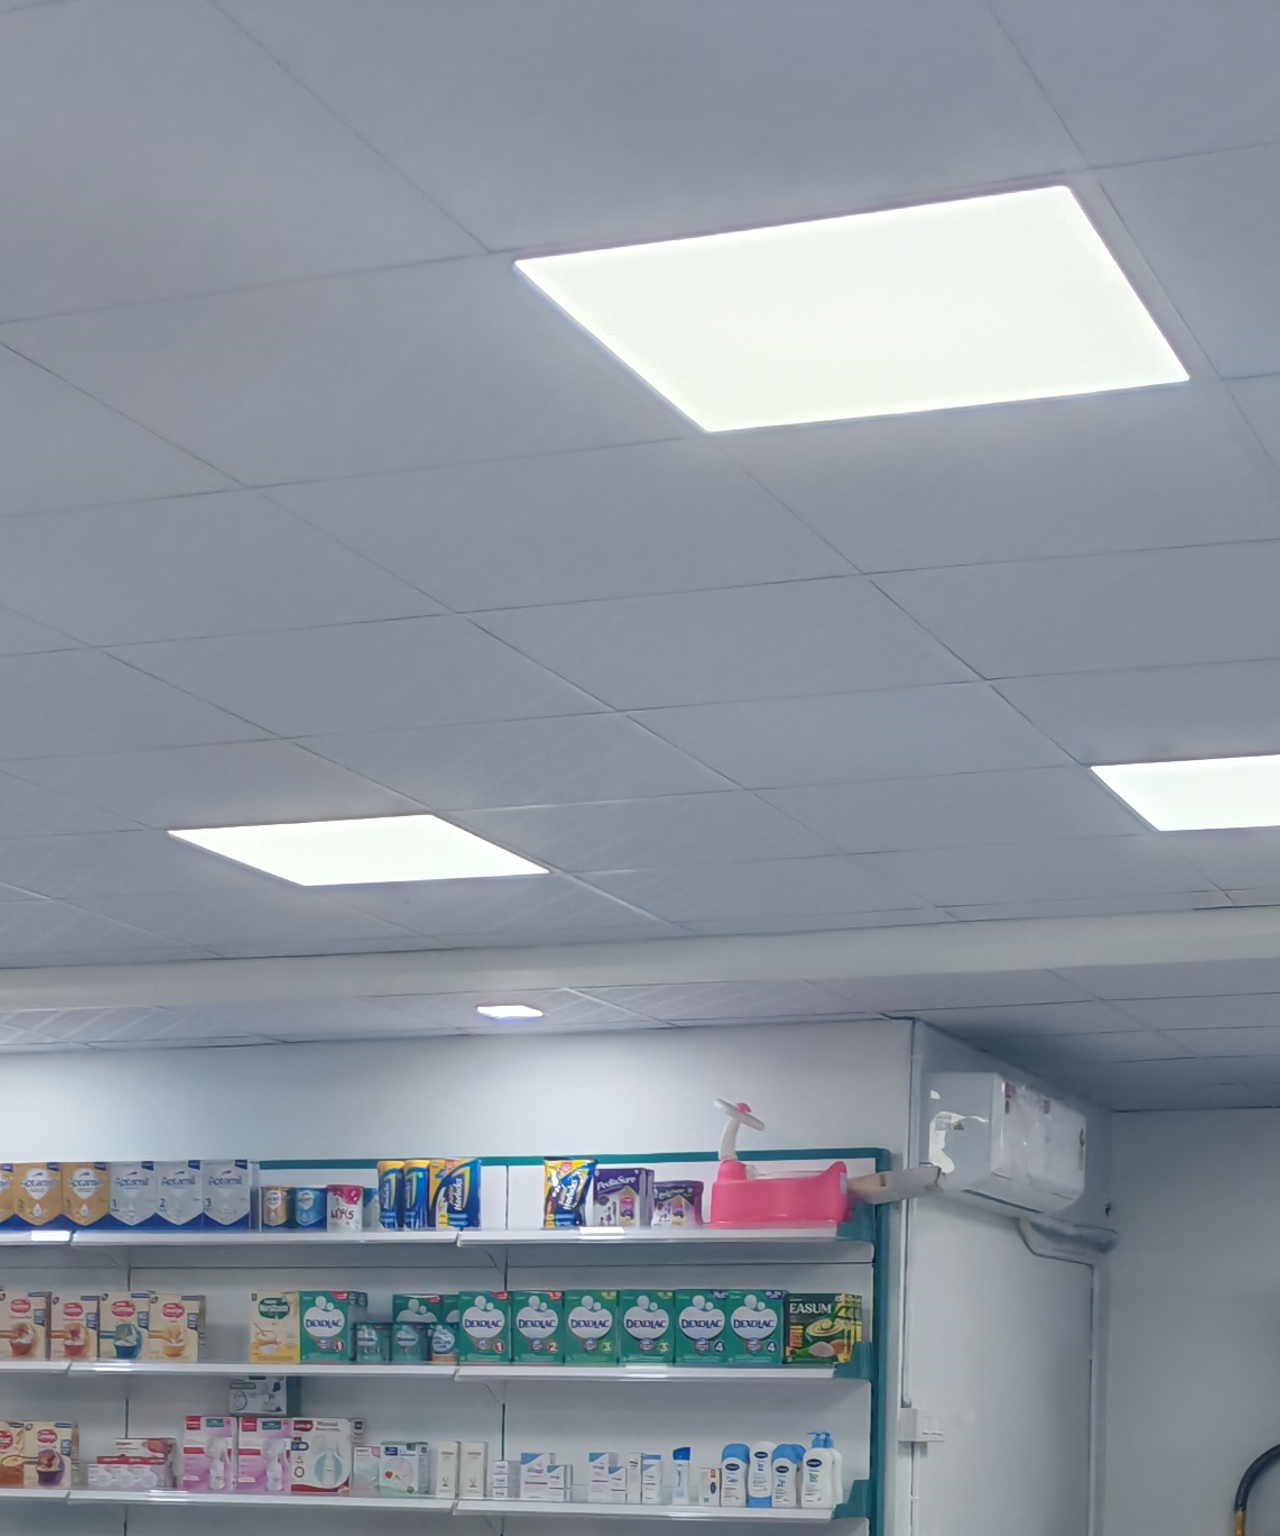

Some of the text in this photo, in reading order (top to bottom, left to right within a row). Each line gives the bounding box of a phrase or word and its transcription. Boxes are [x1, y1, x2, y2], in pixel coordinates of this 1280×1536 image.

[570, 1318, 610, 1329] DEXOLAC
[626, 1318, 667, 1330] DEXOLAC
[681, 1318, 723, 1330] DEXOLAC
[733, 1318, 776, 1330] DEXOLAC
